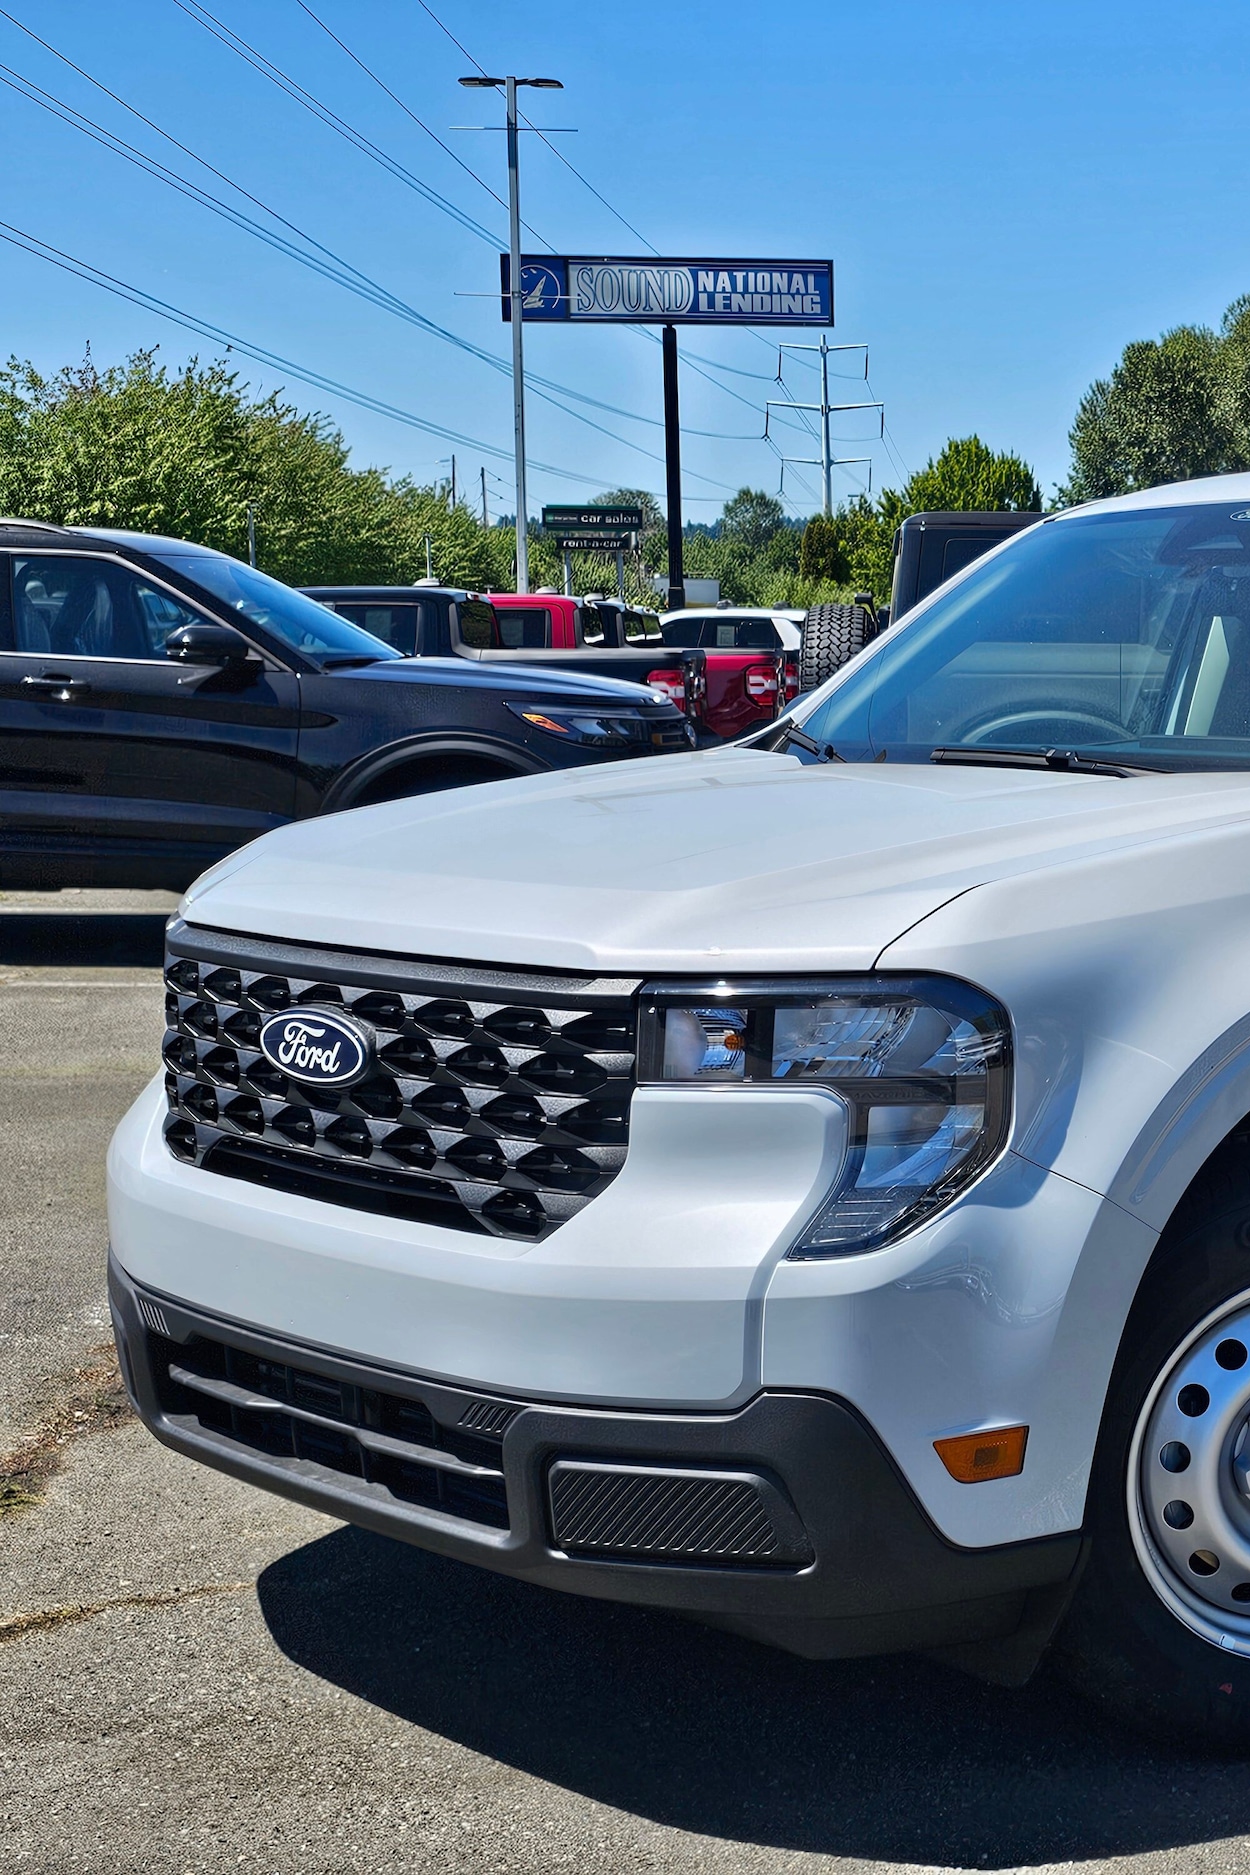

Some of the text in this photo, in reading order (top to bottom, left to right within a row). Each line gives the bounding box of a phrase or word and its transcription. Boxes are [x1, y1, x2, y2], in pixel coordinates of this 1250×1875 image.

[577, 267, 693, 312] SOUND
[697, 270, 820, 294] NATIONAL
[698, 292, 821, 314] LENDING
[580, 514, 602, 523] car
[562, 539, 622, 548] rent-a-car
[278, 1021, 342, 1073] Ford
